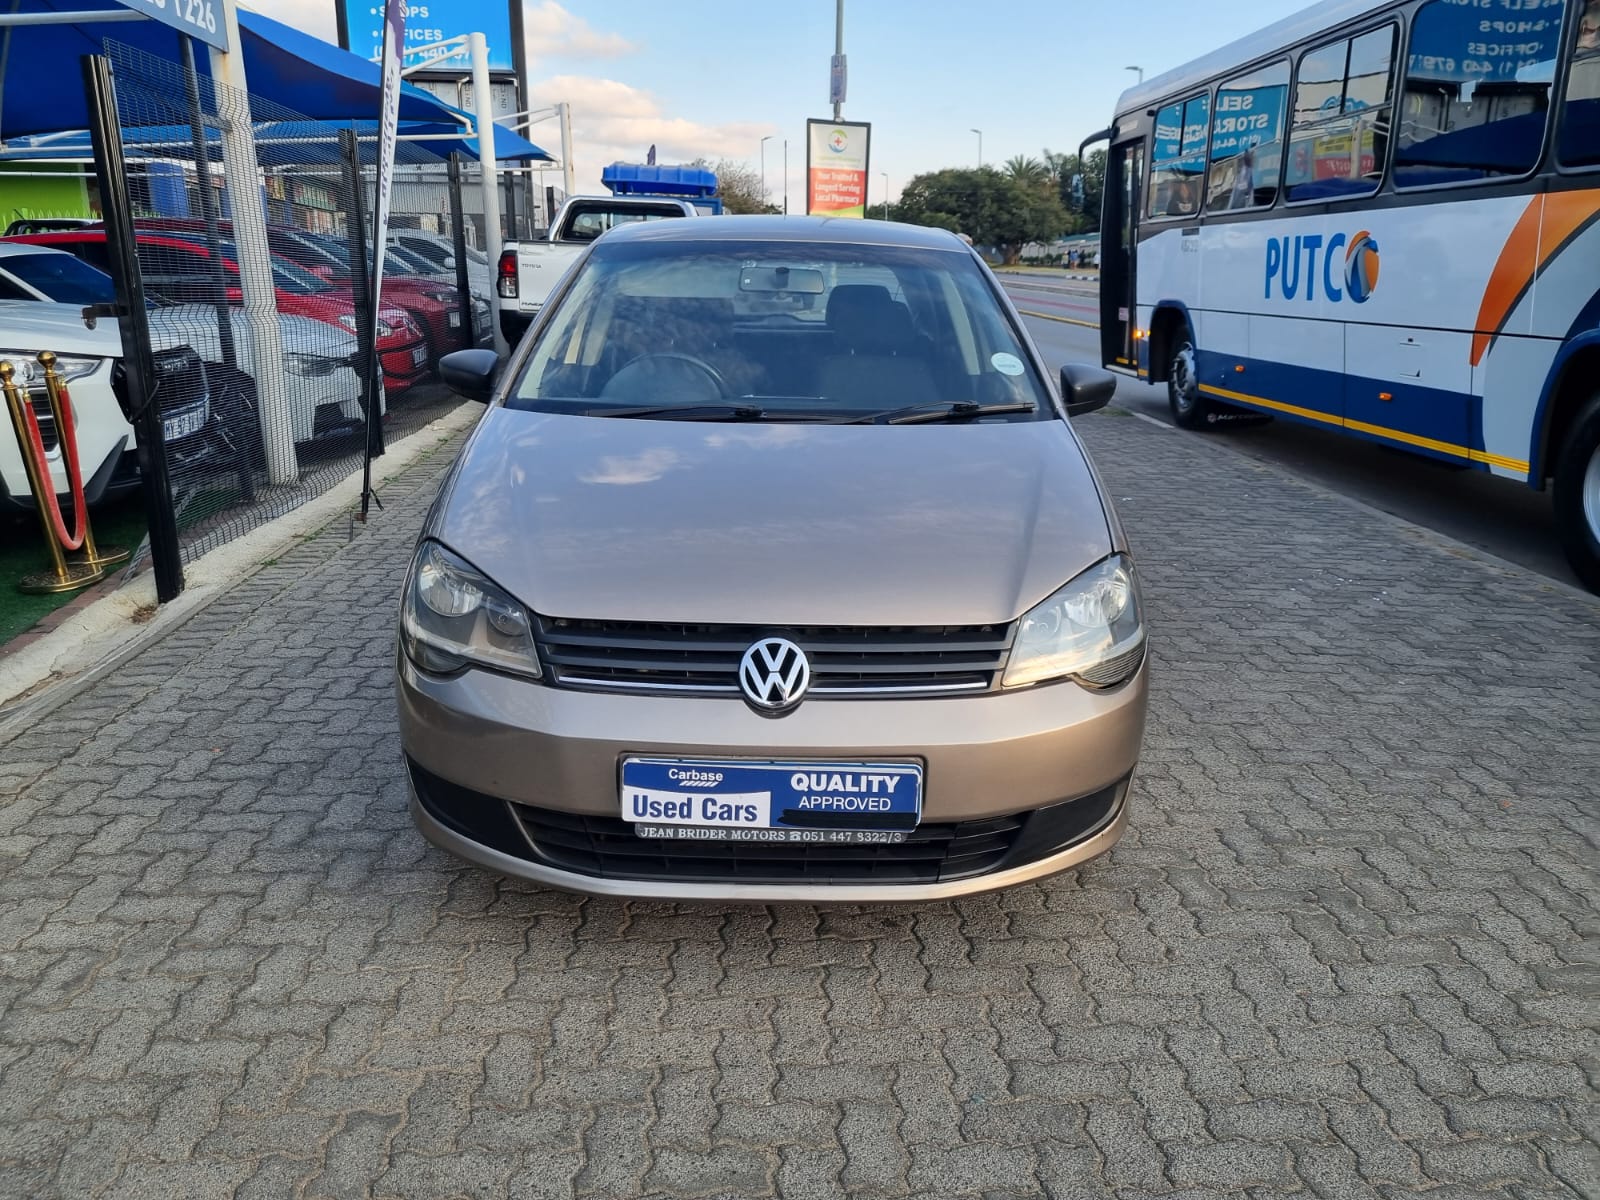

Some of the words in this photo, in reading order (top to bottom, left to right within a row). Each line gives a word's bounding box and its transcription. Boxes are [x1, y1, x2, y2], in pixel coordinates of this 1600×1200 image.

[668, 768, 724, 781] Carbase
[790, 773, 901, 792] QUALITY
[633, 794, 693, 819] Used
[701, 797, 758, 822] Cars
[798, 796, 891, 811] APPROVED
[640, 827, 674, 838] JEAN
[677, 828, 727, 839] BRIDER
[731, 830, 786, 841] MOTORS
[829, 831, 852, 842] 447
